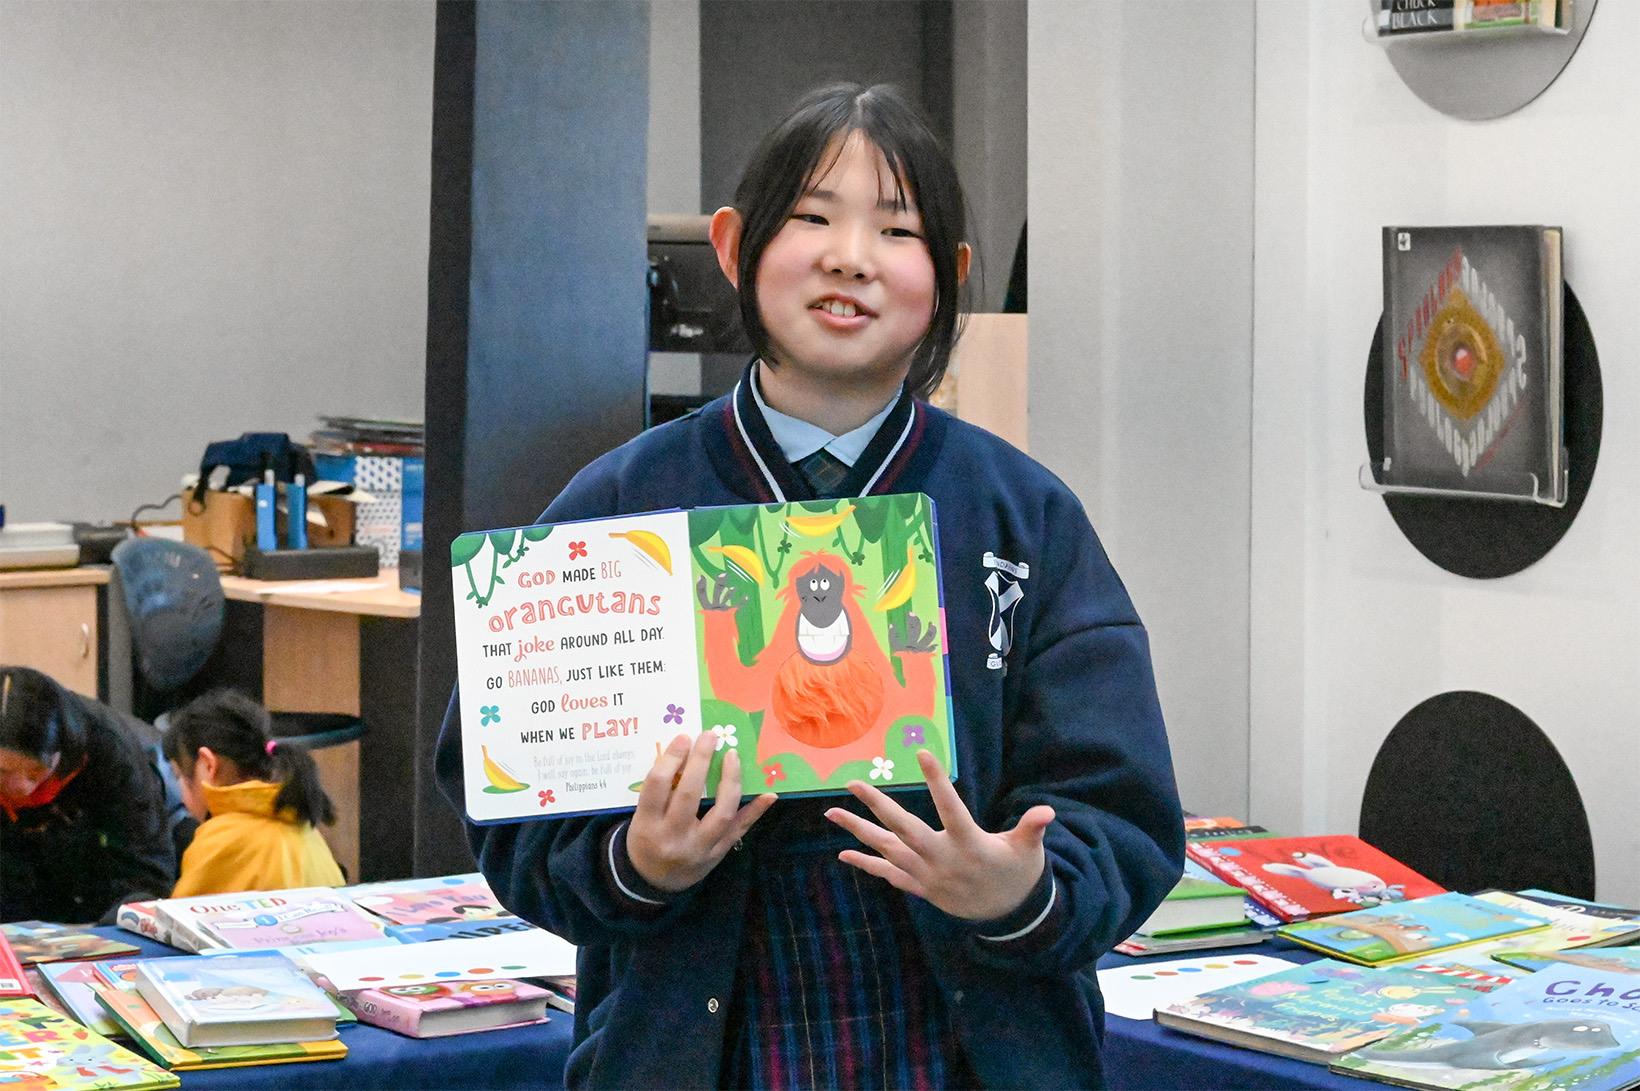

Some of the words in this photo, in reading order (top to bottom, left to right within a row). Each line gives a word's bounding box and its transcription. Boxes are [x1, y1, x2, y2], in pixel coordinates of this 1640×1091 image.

[1391, 9, 1438, 29] BLACK
[517, 570, 556, 588] GOD
[562, 567, 596, 583] MADE
[601, 560, 622, 579] BIG
[482, 642, 512, 658] THAT
[513, 635, 555, 663] joke
[560, 632, 608, 650] AROUND
[613, 629, 635, 645] ALL
[486, 676, 503, 690] GO
[507, 665, 563, 688] BANANAS,
[566, 667, 593, 682] JUST
[598, 663, 625, 679] LIKE
[531, 699, 555, 714] GOD
[561, 693, 608, 713] loves
[613, 692, 624, 706] IT
[520, 730, 554, 743] WHEN
[559, 727, 575, 740] WE
